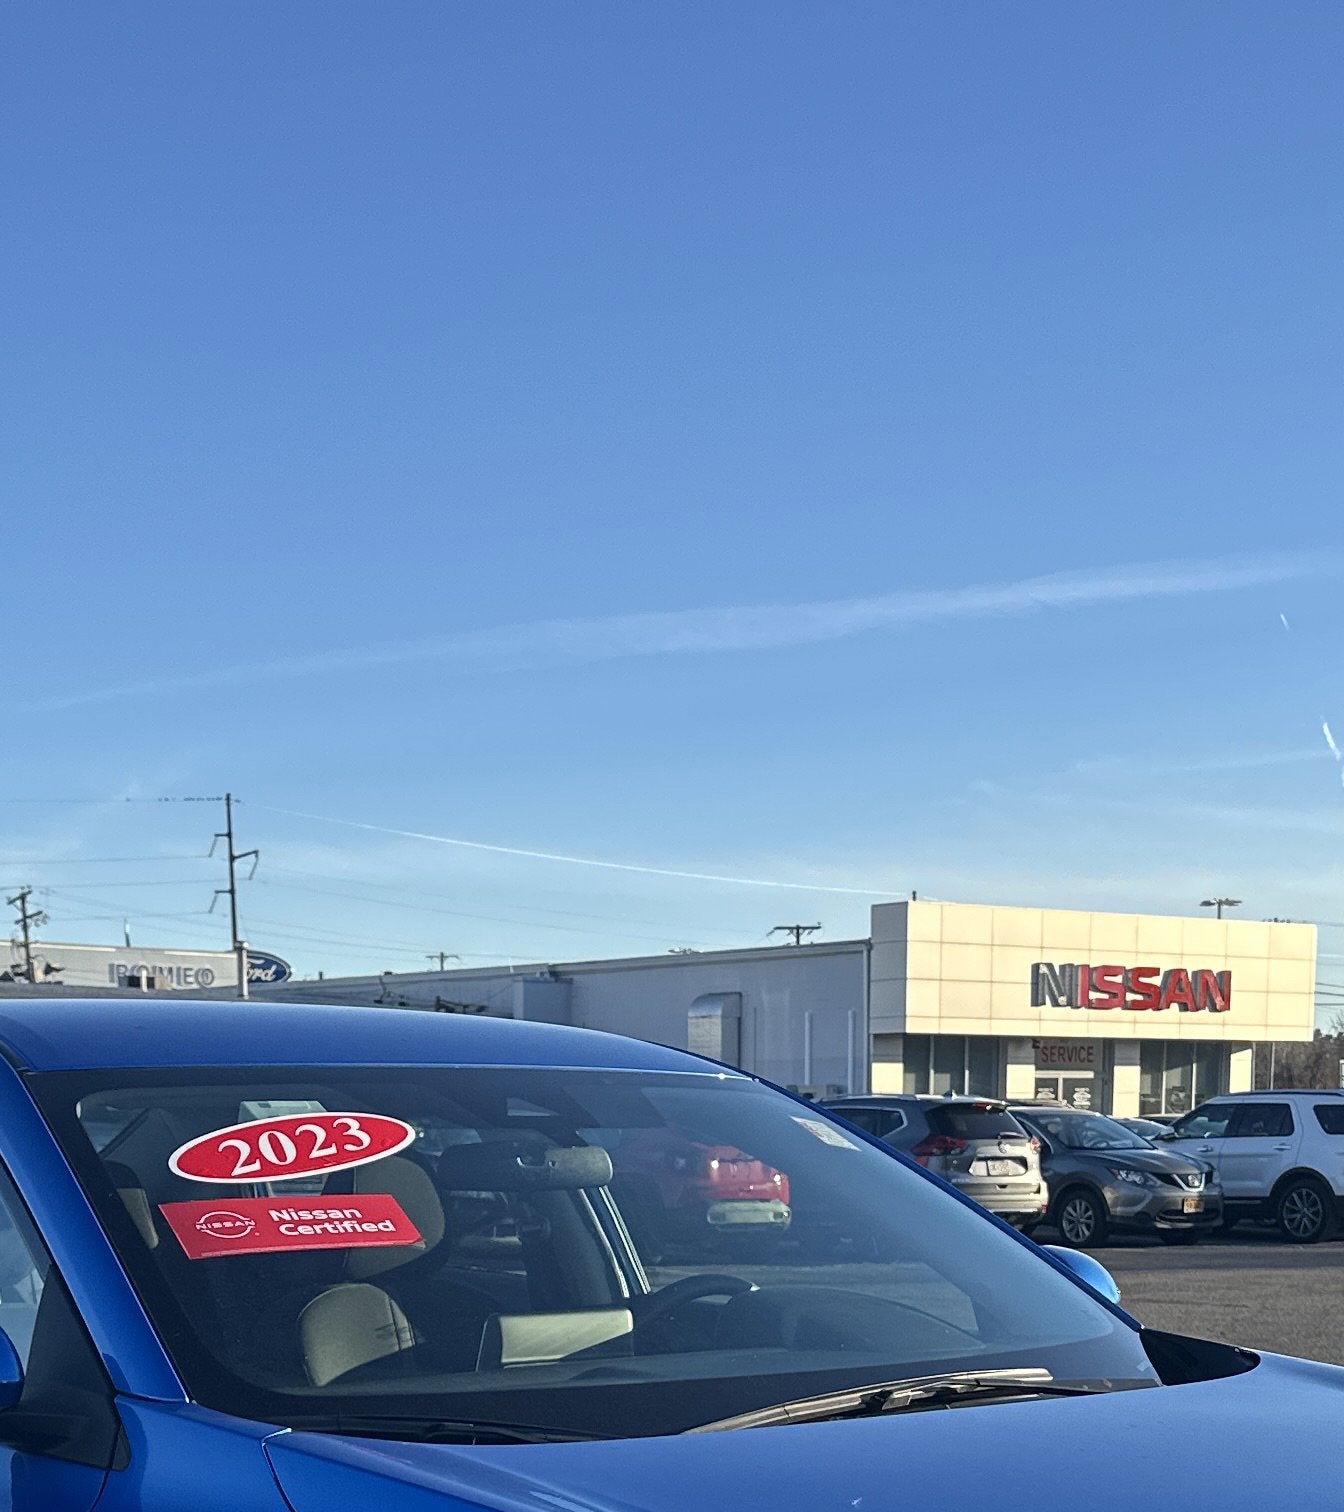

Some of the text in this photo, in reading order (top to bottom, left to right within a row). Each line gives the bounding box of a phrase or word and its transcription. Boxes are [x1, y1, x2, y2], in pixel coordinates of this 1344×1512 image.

[246, 957, 275, 981] ord
[1031, 962, 1231, 1012] NISSAN
[1040, 1045, 1094, 1063] SERVICE
[217, 1117, 372, 1177] 2023
[268, 1207, 363, 1223] Nissan
[195, 1217, 256, 1232] NISSAN
[278, 1219, 396, 1237] Certified
